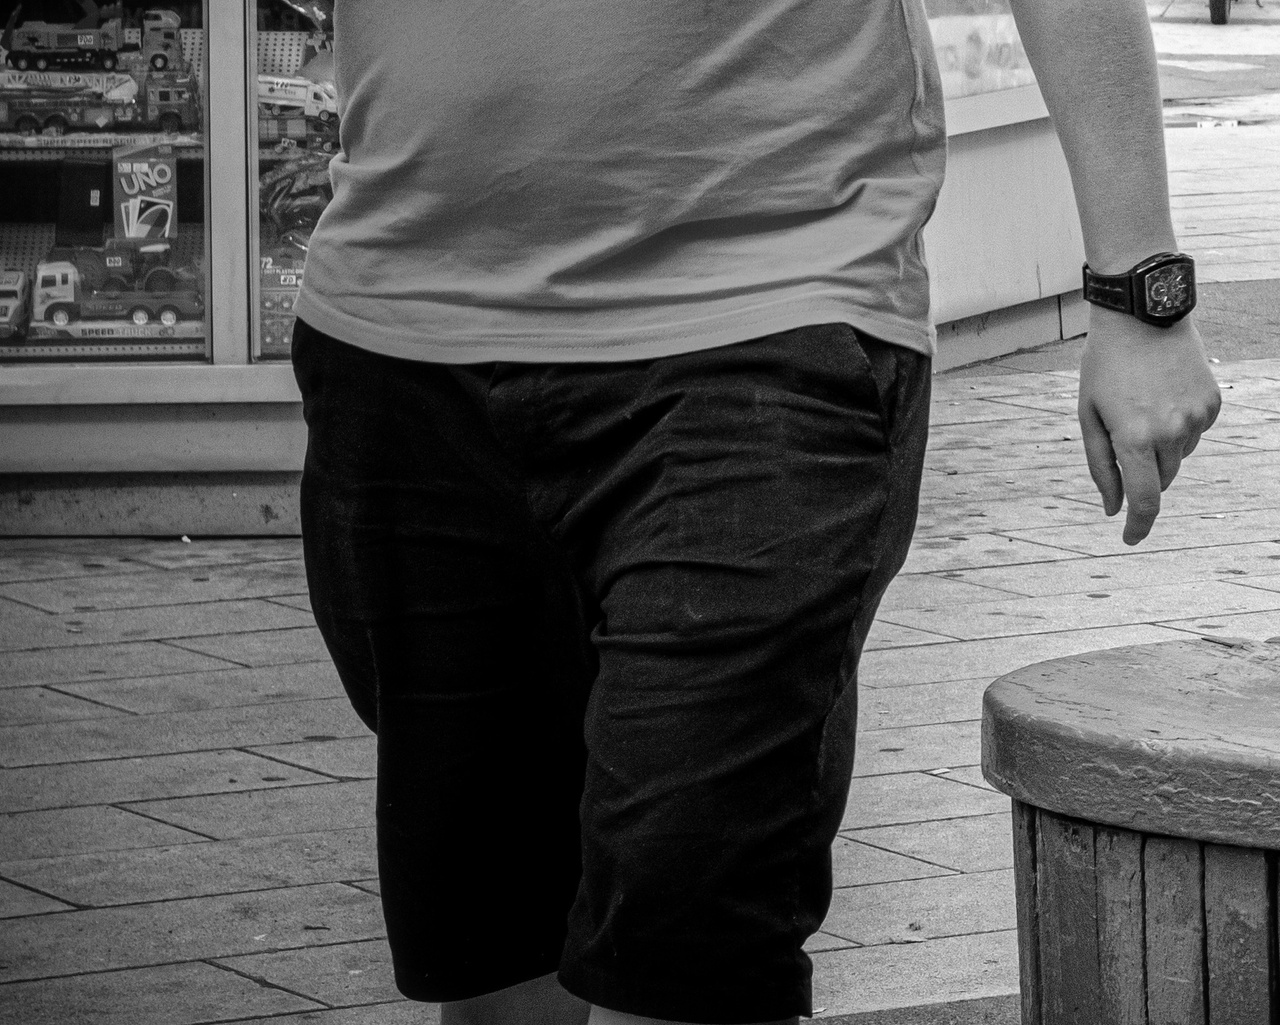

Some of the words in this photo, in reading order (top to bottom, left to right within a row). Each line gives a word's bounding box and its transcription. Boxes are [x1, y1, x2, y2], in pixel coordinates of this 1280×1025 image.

[120, 163, 172, 196] UNO
[260, 256, 273, 269] 72
[81, 328, 114, 337] SPEED
[117, 327, 152, 337] TRUCK
